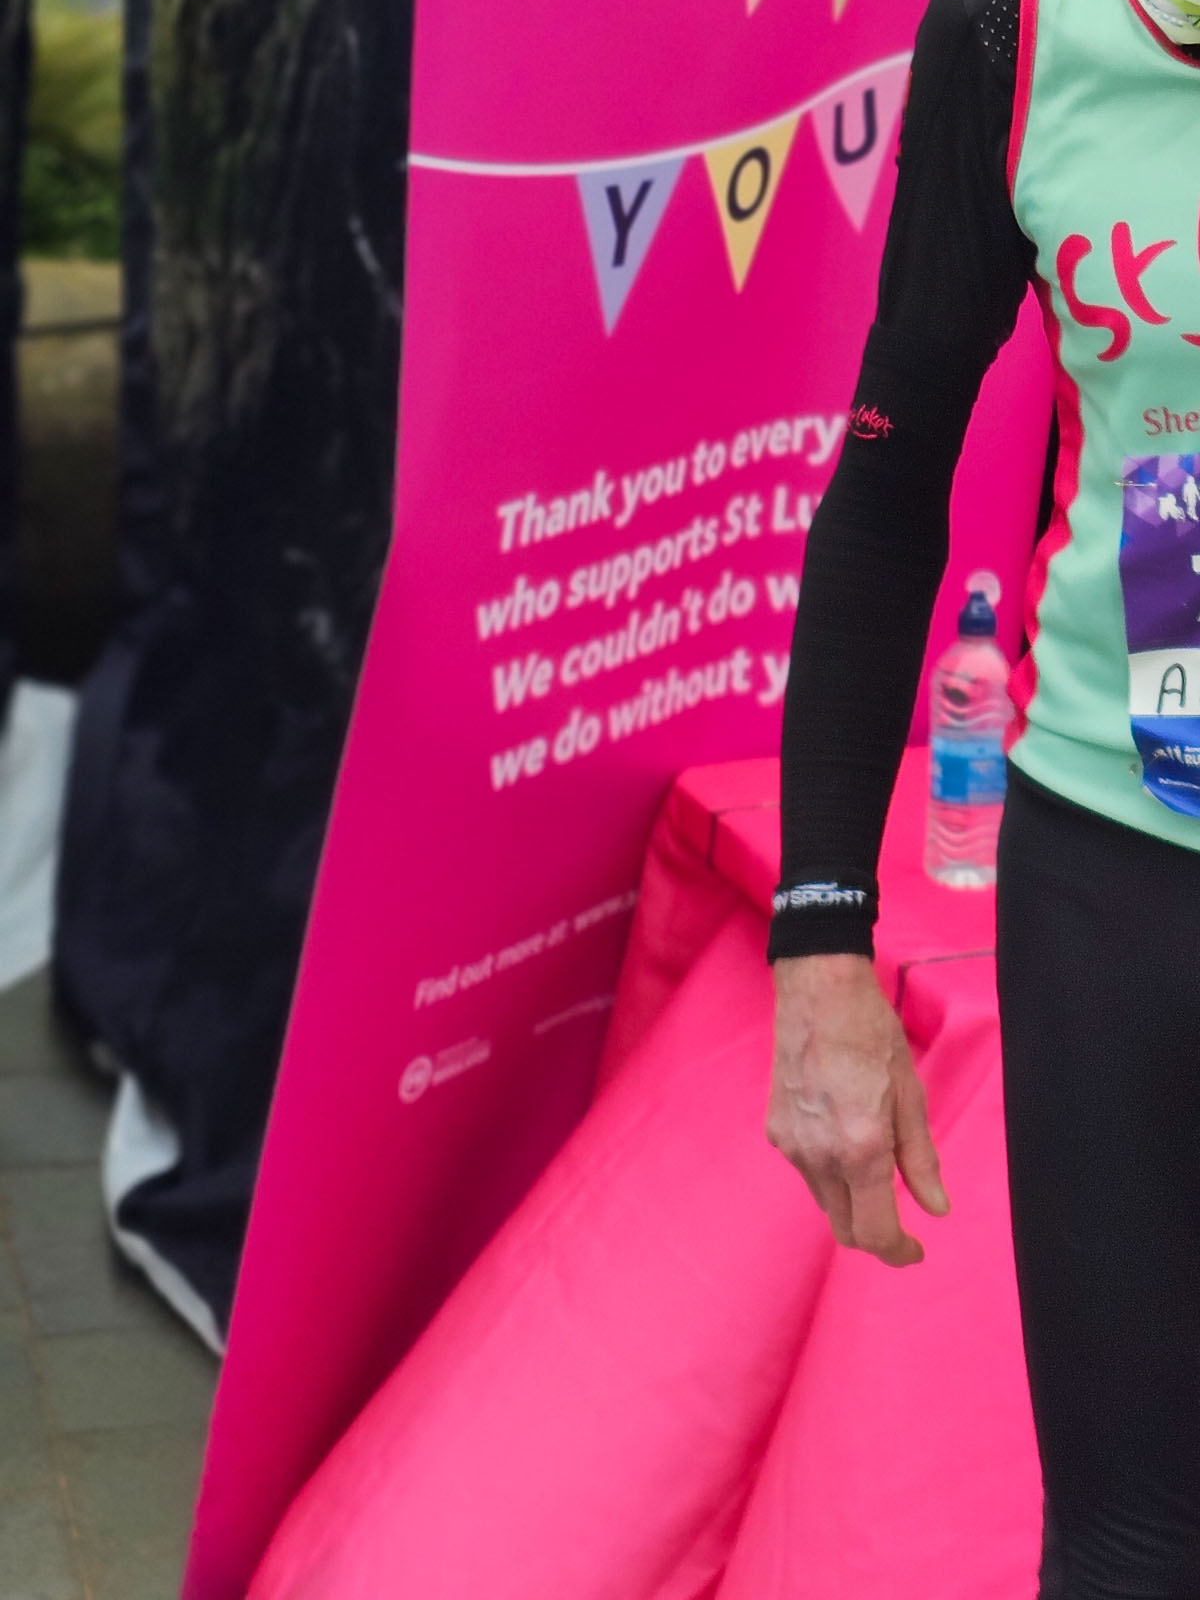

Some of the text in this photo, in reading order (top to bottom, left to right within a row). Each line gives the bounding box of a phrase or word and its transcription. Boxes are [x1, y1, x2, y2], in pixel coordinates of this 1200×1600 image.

[604, 87, 878, 269] YOU
[1055, 220, 1178, 363] St
[497, 414, 847, 554] Thank you to every
[476, 575, 560, 641] who
[566, 514, 718, 609] supports
[723, 492, 762, 546] St
[491, 653, 554, 714] We
[560, 586, 706, 685] couldn't
[708, 571, 755, 624] do
[489, 736, 548, 792] we
[553, 707, 600, 764] do
[608, 647, 752, 742] without
[413, 965, 460, 1010] Find
[459, 953, 494, 990] out
[495, 932, 546, 971] more
